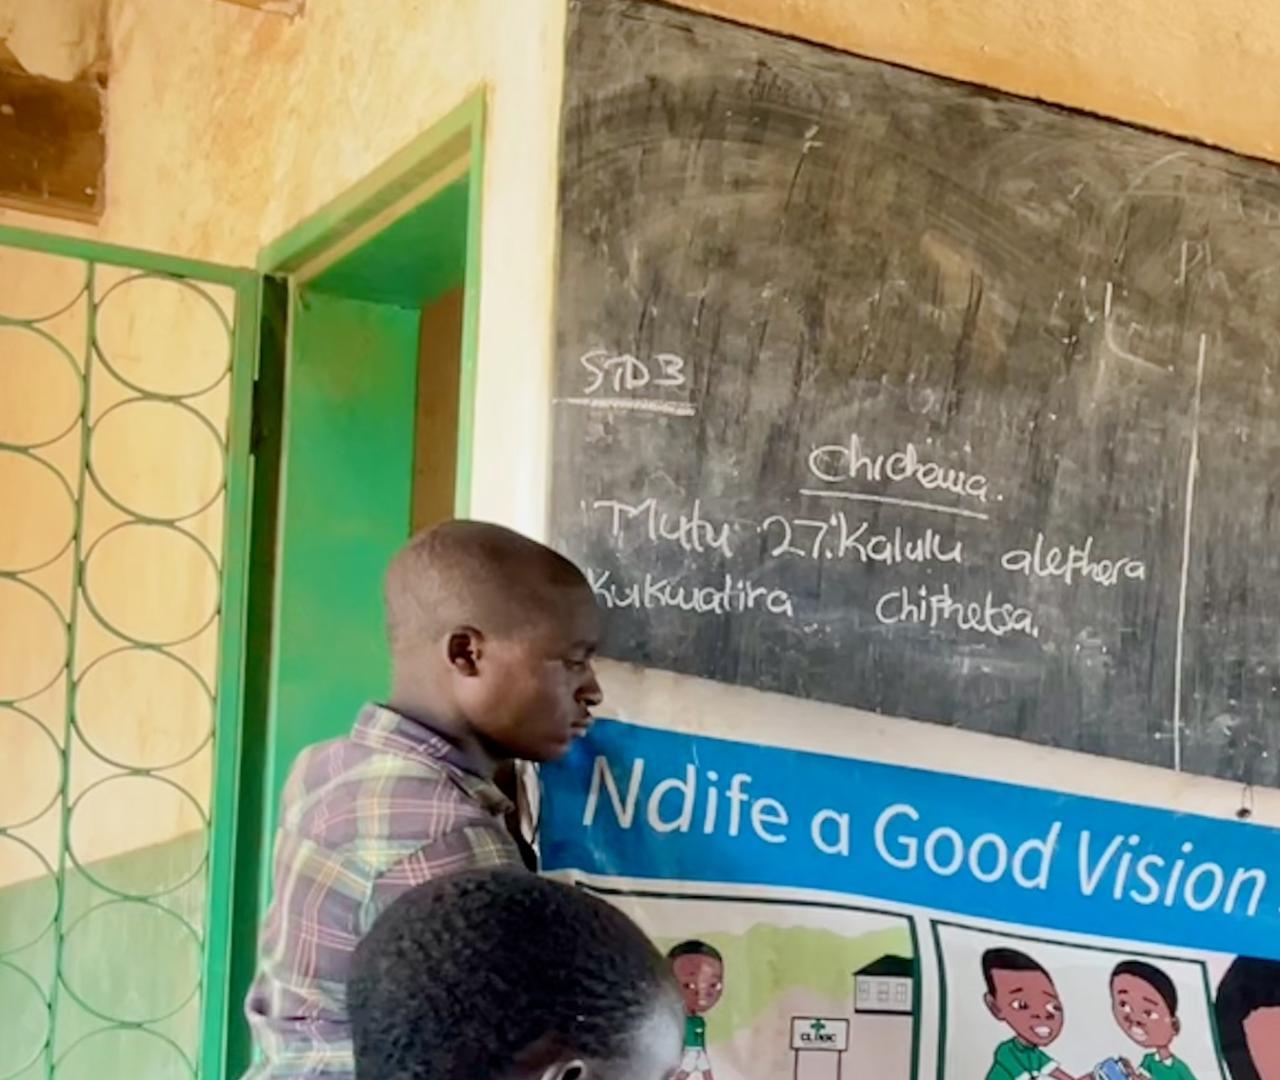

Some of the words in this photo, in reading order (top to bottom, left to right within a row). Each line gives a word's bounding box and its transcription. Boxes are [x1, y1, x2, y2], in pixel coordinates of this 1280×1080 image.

[582, 755, 789, 843] Ndife
[811, 809, 849, 857] a
[874, 803, 1062, 890] Good
[1078, 830, 1267, 917] Vision
